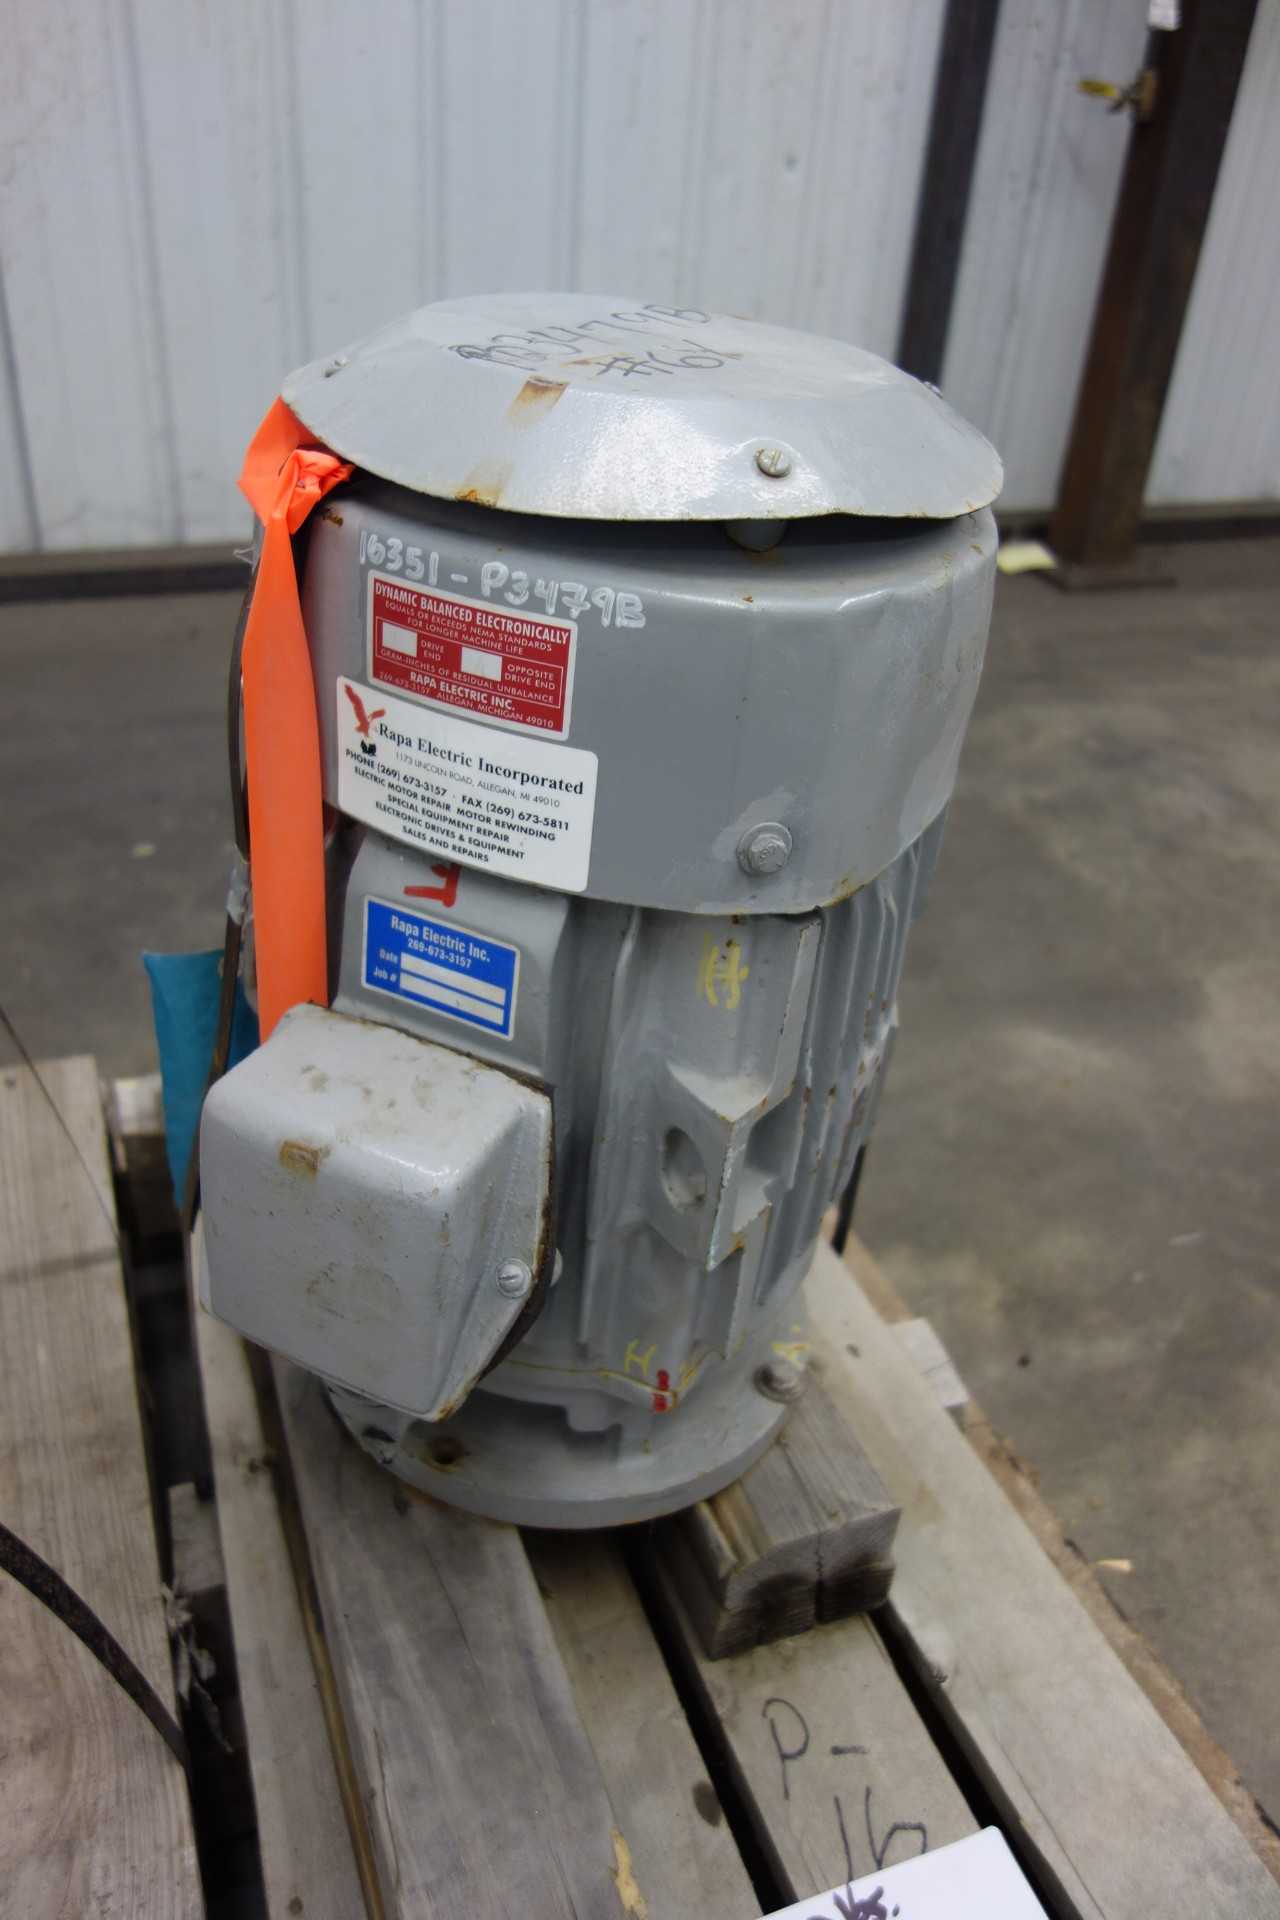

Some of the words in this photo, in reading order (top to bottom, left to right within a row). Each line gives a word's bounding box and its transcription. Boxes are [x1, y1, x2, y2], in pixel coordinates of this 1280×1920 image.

[376, 582, 418, 608] DYNAMIC
[420, 597, 473, 622] BALANCED
[476, 612, 570, 645] ELECTRONICALLY
[385, 601, 415, 616] EQUALS
[417, 611, 428, 620] OR
[431, 615, 467, 632] EXCEEDS
[470, 627, 495, 639] NEMA
[498, 633, 552, 652] STANDARDS
[407, 617, 422, 627] FOR
[425, 623, 459, 639] LONGER
[461, 634, 502, 650] MACHINE
[506, 645, 524, 655] LIFE
[380, 648, 436, 672] GRAM-INCHES
[438, 667, 449, 677] OF
[453, 672, 493, 689] RESIDUAL
[497, 684, 554, 704] UNBALANCE
[421, 640, 444, 653] DRIVE
[507, 664, 554, 681] OPPOSITE
[423, 650, 441, 661] END
[504, 673, 531, 685] DRIVE
[535, 680, 556, 690] END
[410, 671, 437, 689] RAPA
[440, 682, 488, 703] ELECTRIC
[491, 696, 515, 711] INC.
[477, 704, 523, 720] MICHIGAN
[526, 715, 554, 728] 49010
[379, 723, 412, 747] Rapa
[418, 738, 472, 768] Electric
[478, 757, 584, 795] Incorporated
[345, 748, 375, 768] PHONE
[377, 762, 401, 781] (269)
[402, 774, 448, 796] 673-3157
[461, 795, 482, 808] FAX
[486, 801, 515, 818] (269)
[518, 811, 570, 831] 673-5811
[354, 766, 386, 786] ELECTRIC
[387, 782, 418, 799] MOTOR
[421, 794, 452, 811] REPAIR
[456, 808, 491, 825] MOTOR
[494, 820, 556, 841] REWINDING
[414, 759, 447, 777] LINCOLN
[520, 791, 531, 801] MI
[533, 796, 561, 808] 49010
[375, 801, 423, 827] ELECTRONIC
[425, 821, 456, 838] DRIVES
[458, 833, 465, 842] &
[467, 836, 525, 860] EQUIPMENT
[387, 794, 419, 813] SPECIAL
[421, 808, 474, 832] EQUIPMENT
[476, 826, 510, 842] REPAIR
[402, 826, 427, 841] SALES
[428, 836, 449, 849] AND
[452, 844, 489, 862] REPAIRS
[379, 948, 399, 964] Date
[391, 914, 420, 937] Rapa
[422, 926, 466, 953] Electric
[469, 942, 491, 962] Inc.
[407, 938, 472, 969] 269-673-3157
[373, 966, 388, 981] Job
